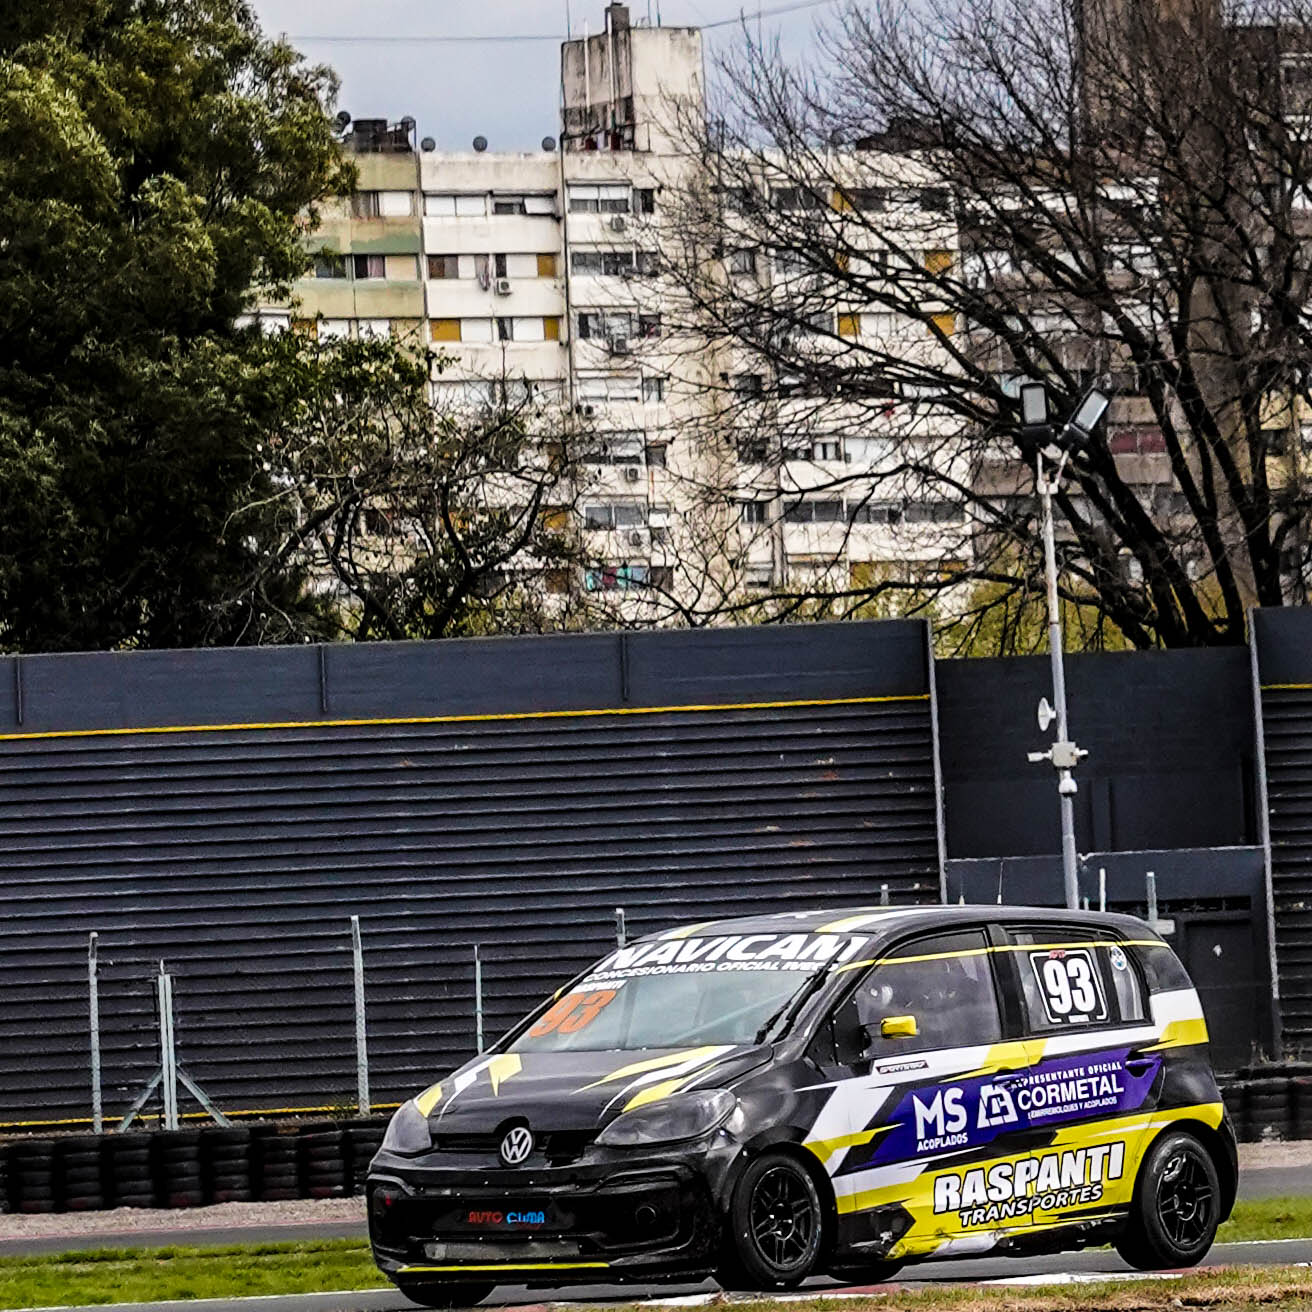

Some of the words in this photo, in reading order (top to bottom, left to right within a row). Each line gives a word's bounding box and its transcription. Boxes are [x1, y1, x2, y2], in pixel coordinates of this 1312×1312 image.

[583, 962, 716, 982] CONCESIONARIO
[716, 961, 779, 972] OFICIAL
[593, 934, 869, 973] NAVICAM
[1043, 957, 1096, 1014] 93
[529, 989, 617, 1038] 93
[1088, 1061, 1123, 1075] OFICIAL
[1017, 1073, 1125, 1111] CORMETAL
[912, 1087, 968, 1140] MS
[916, 1132, 968, 1152] ACOPLADOS
[934, 1141, 1126, 1214] RASPANTI
[468, 1211, 504, 1224] AUTO
[959, 1184, 1103, 1227] TRANSPORTES
